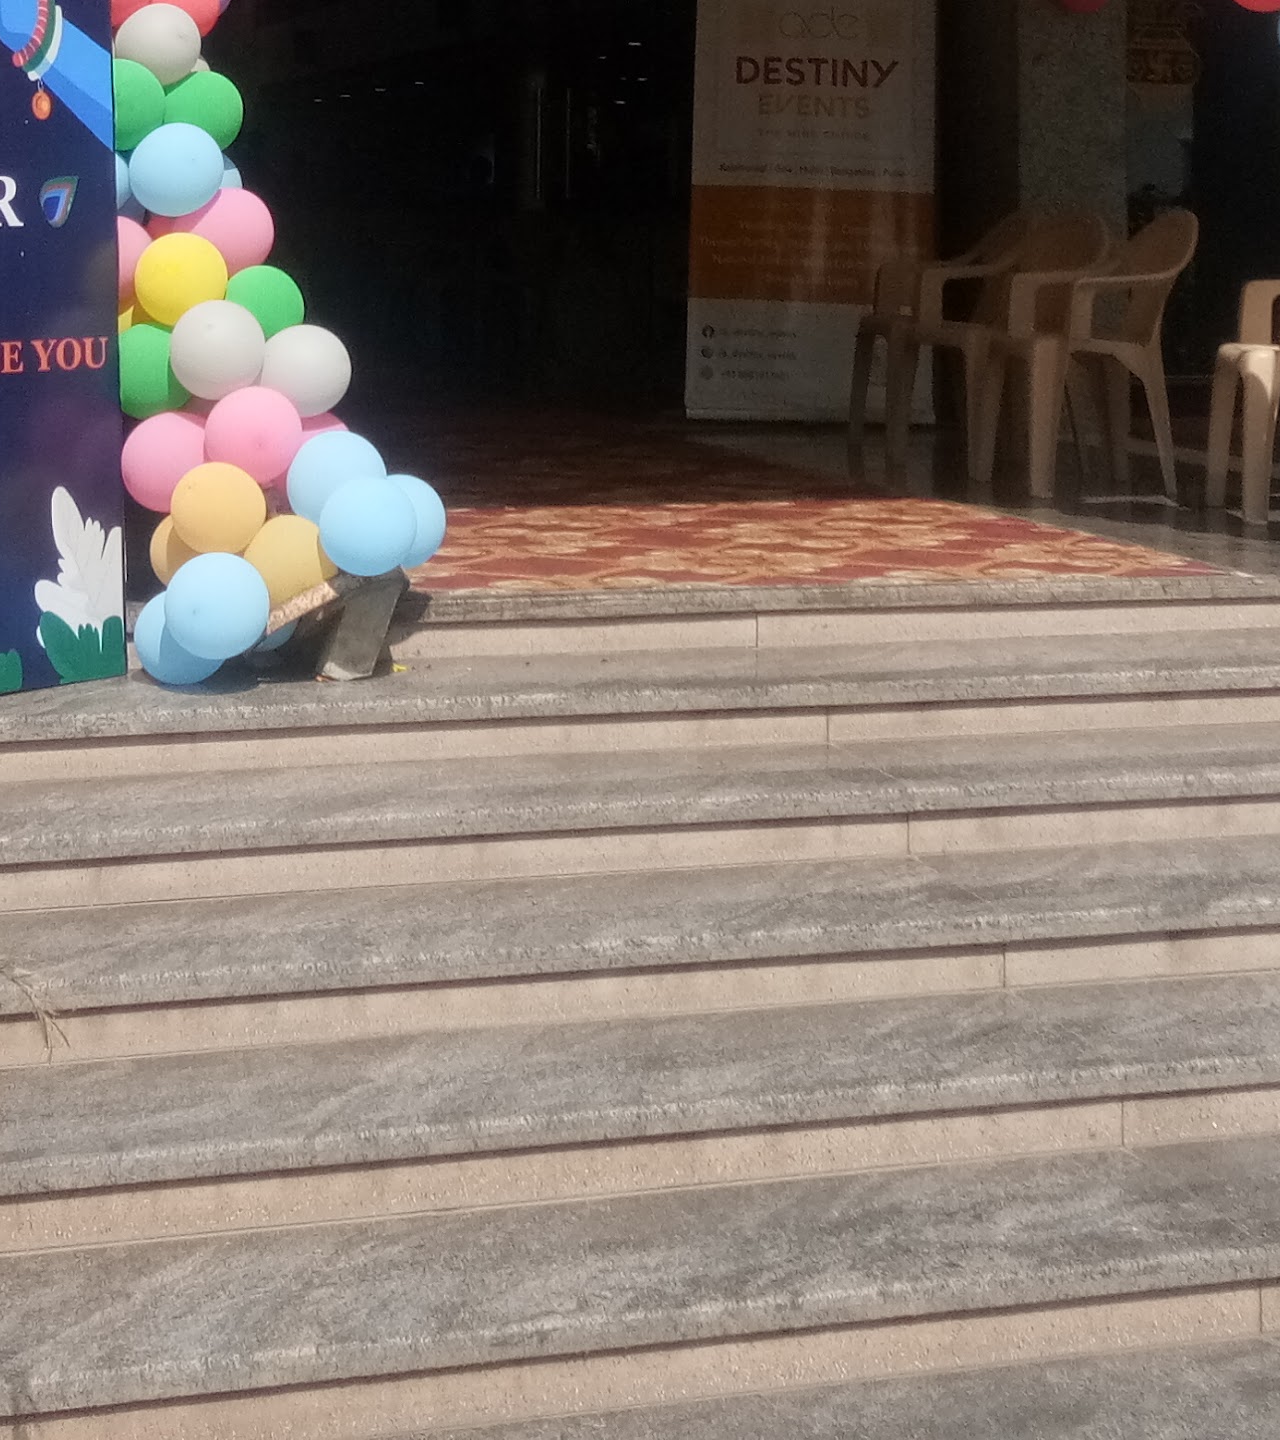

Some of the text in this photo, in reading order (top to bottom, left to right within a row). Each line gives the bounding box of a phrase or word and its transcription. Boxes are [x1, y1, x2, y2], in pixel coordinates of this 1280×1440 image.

[735, 56, 899, 88] DESTINY
[758, 93, 870, 119] EVENTS
[30, 336, 109, 371] YOU
